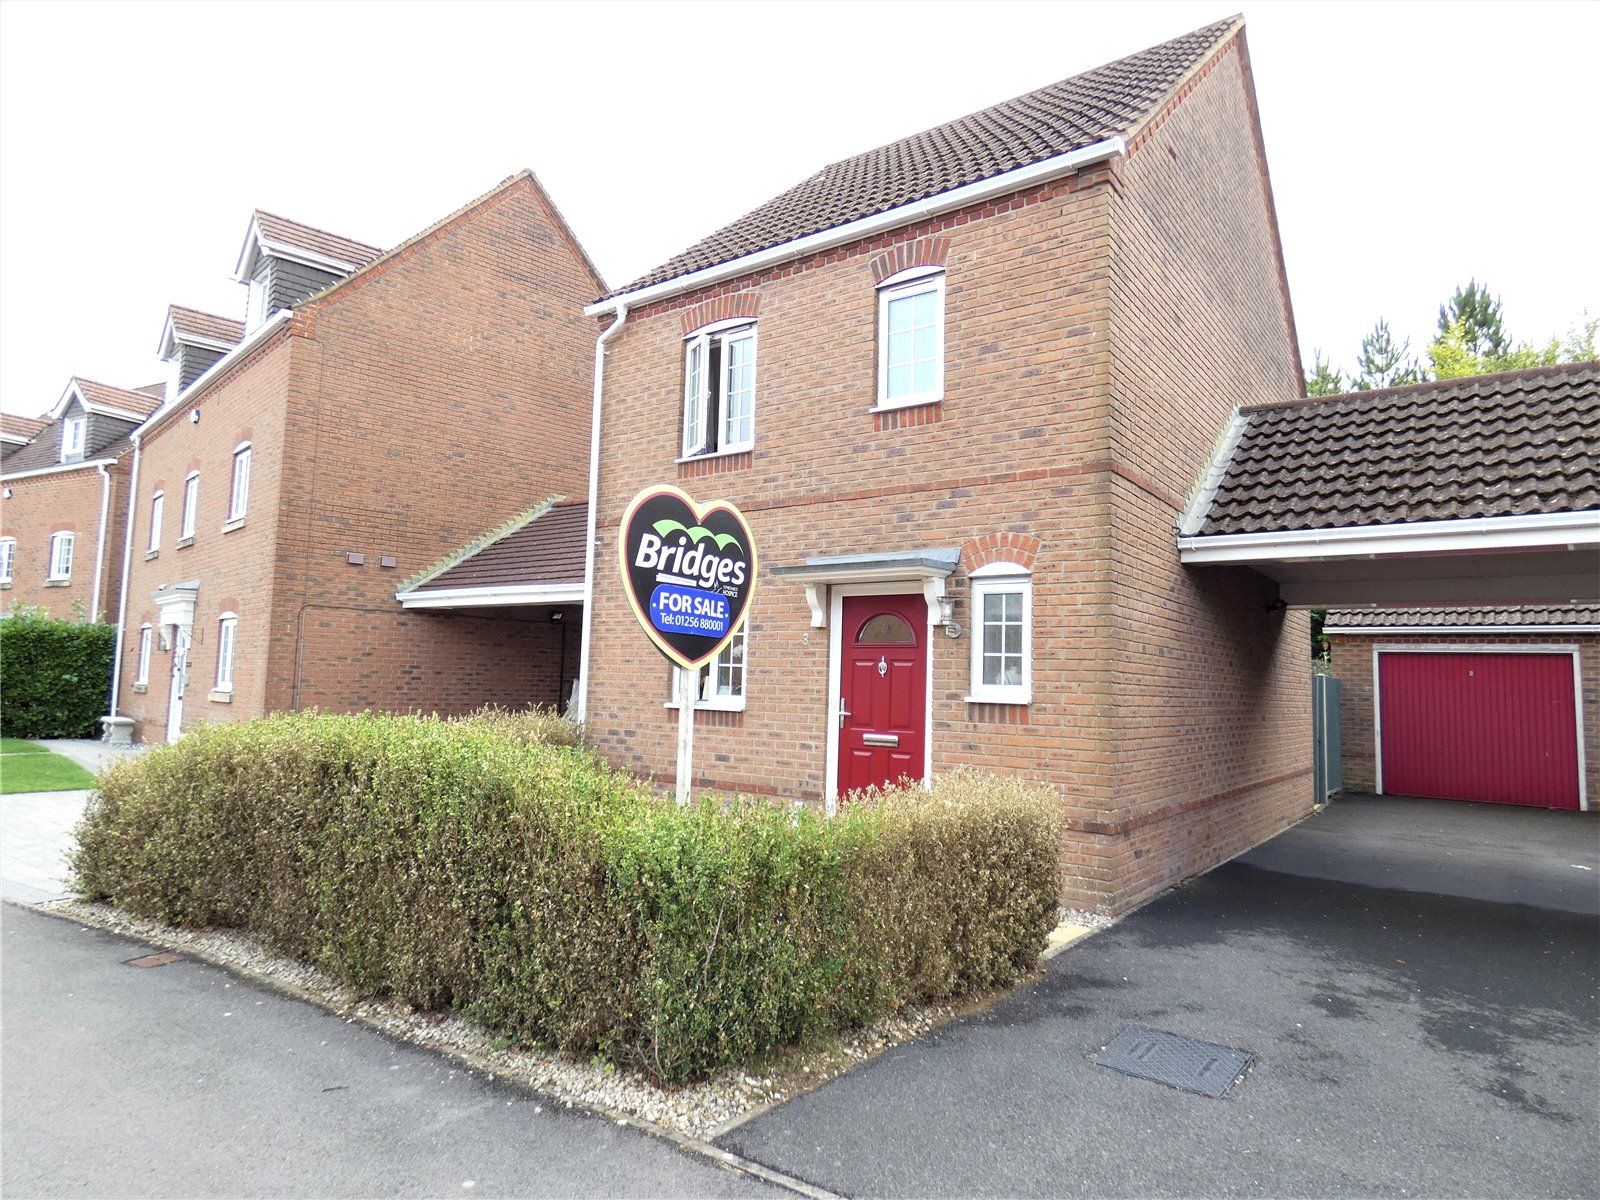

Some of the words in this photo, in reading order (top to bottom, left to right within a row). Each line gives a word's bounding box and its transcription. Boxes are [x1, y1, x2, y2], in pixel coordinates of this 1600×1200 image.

[635, 533, 746, 588] Bridges
[659, 592, 692, 613] FOR
[694, 597, 725, 618] SALE
[660, 612, 675, 625] Tel:
[675, 615, 699, 628] 01256
[700, 618, 724, 631] 880001
